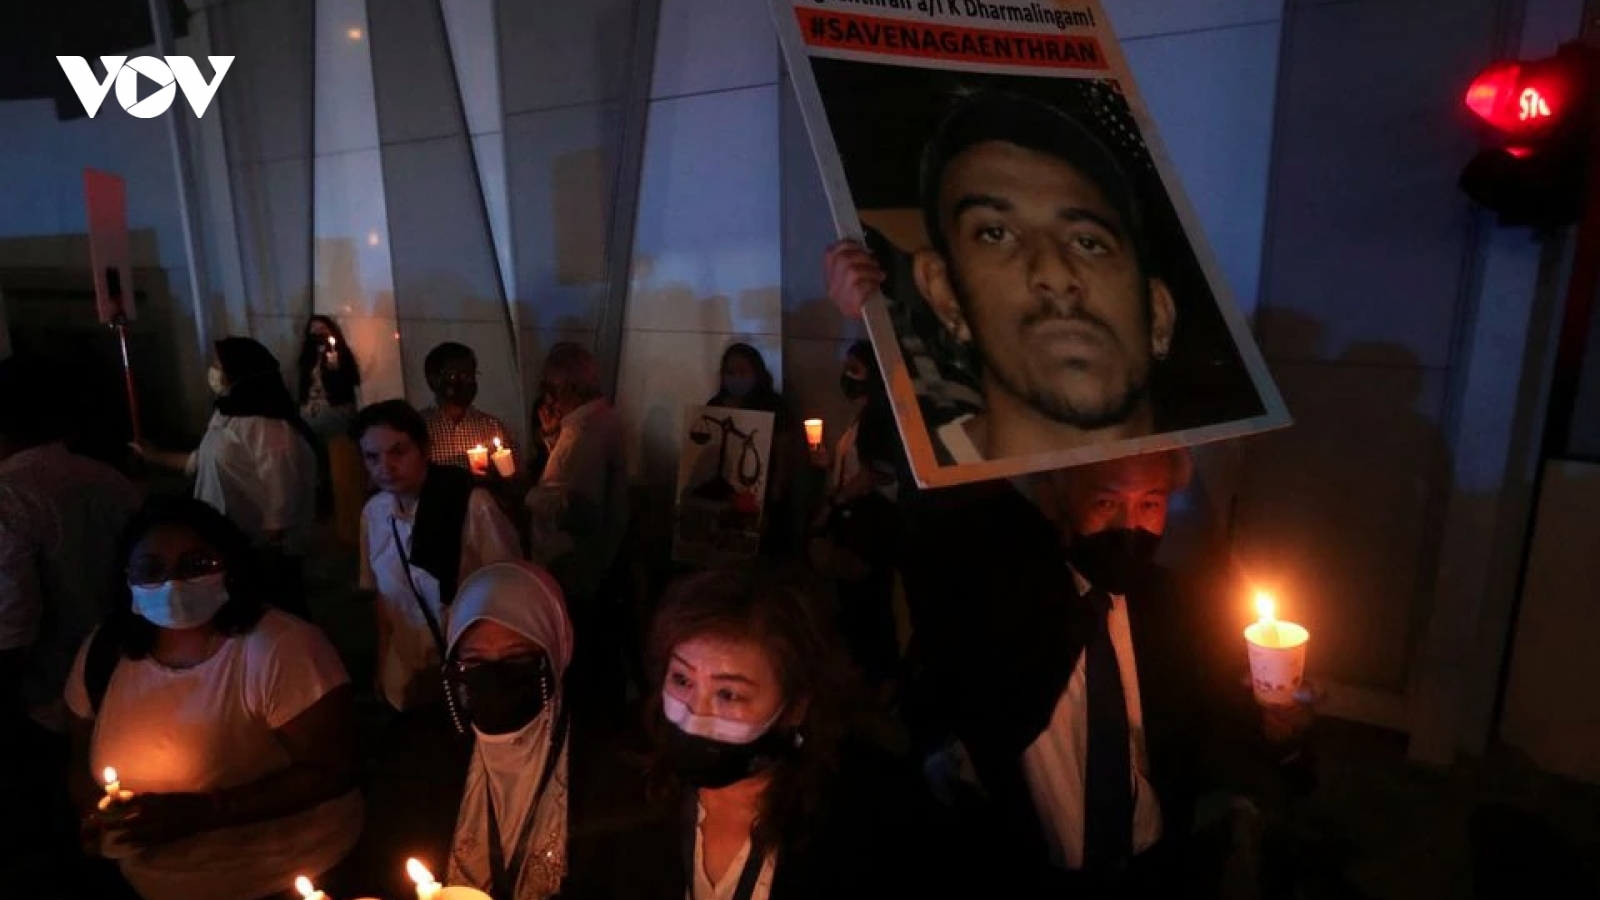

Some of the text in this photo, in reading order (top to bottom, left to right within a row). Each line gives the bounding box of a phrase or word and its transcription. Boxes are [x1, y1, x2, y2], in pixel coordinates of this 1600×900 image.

[948, 0, 961, 16] K
[964, 0, 1096, 29] Dharmalingam!
[810, 15, 1096, 63] #SAVENAGAENTHRAN
